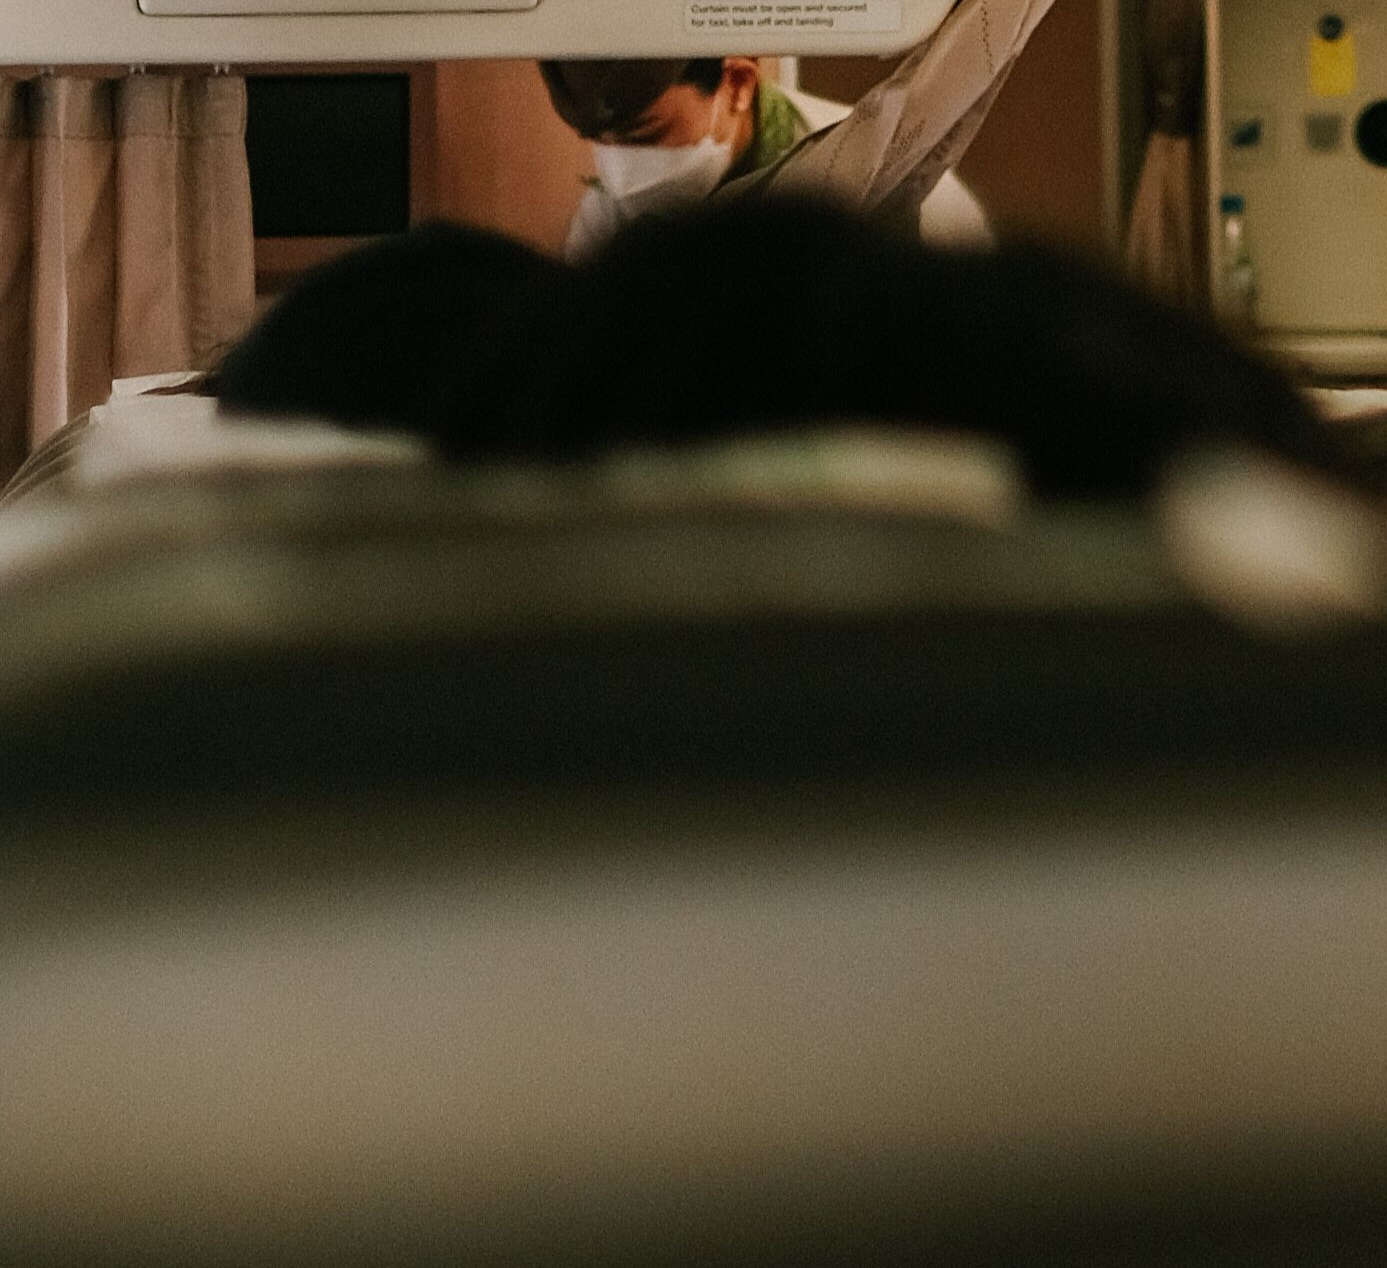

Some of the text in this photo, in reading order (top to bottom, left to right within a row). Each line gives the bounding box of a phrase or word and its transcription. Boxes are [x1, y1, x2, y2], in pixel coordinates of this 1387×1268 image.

[690, 2, 868, 14] Curtain must be open and secured
[691, 18, 705, 27] for
[732, 17, 754, 27] take
[757, 16, 772, 26] off
[774, 17, 794, 27] and
[795, 16, 834, 28] landing
